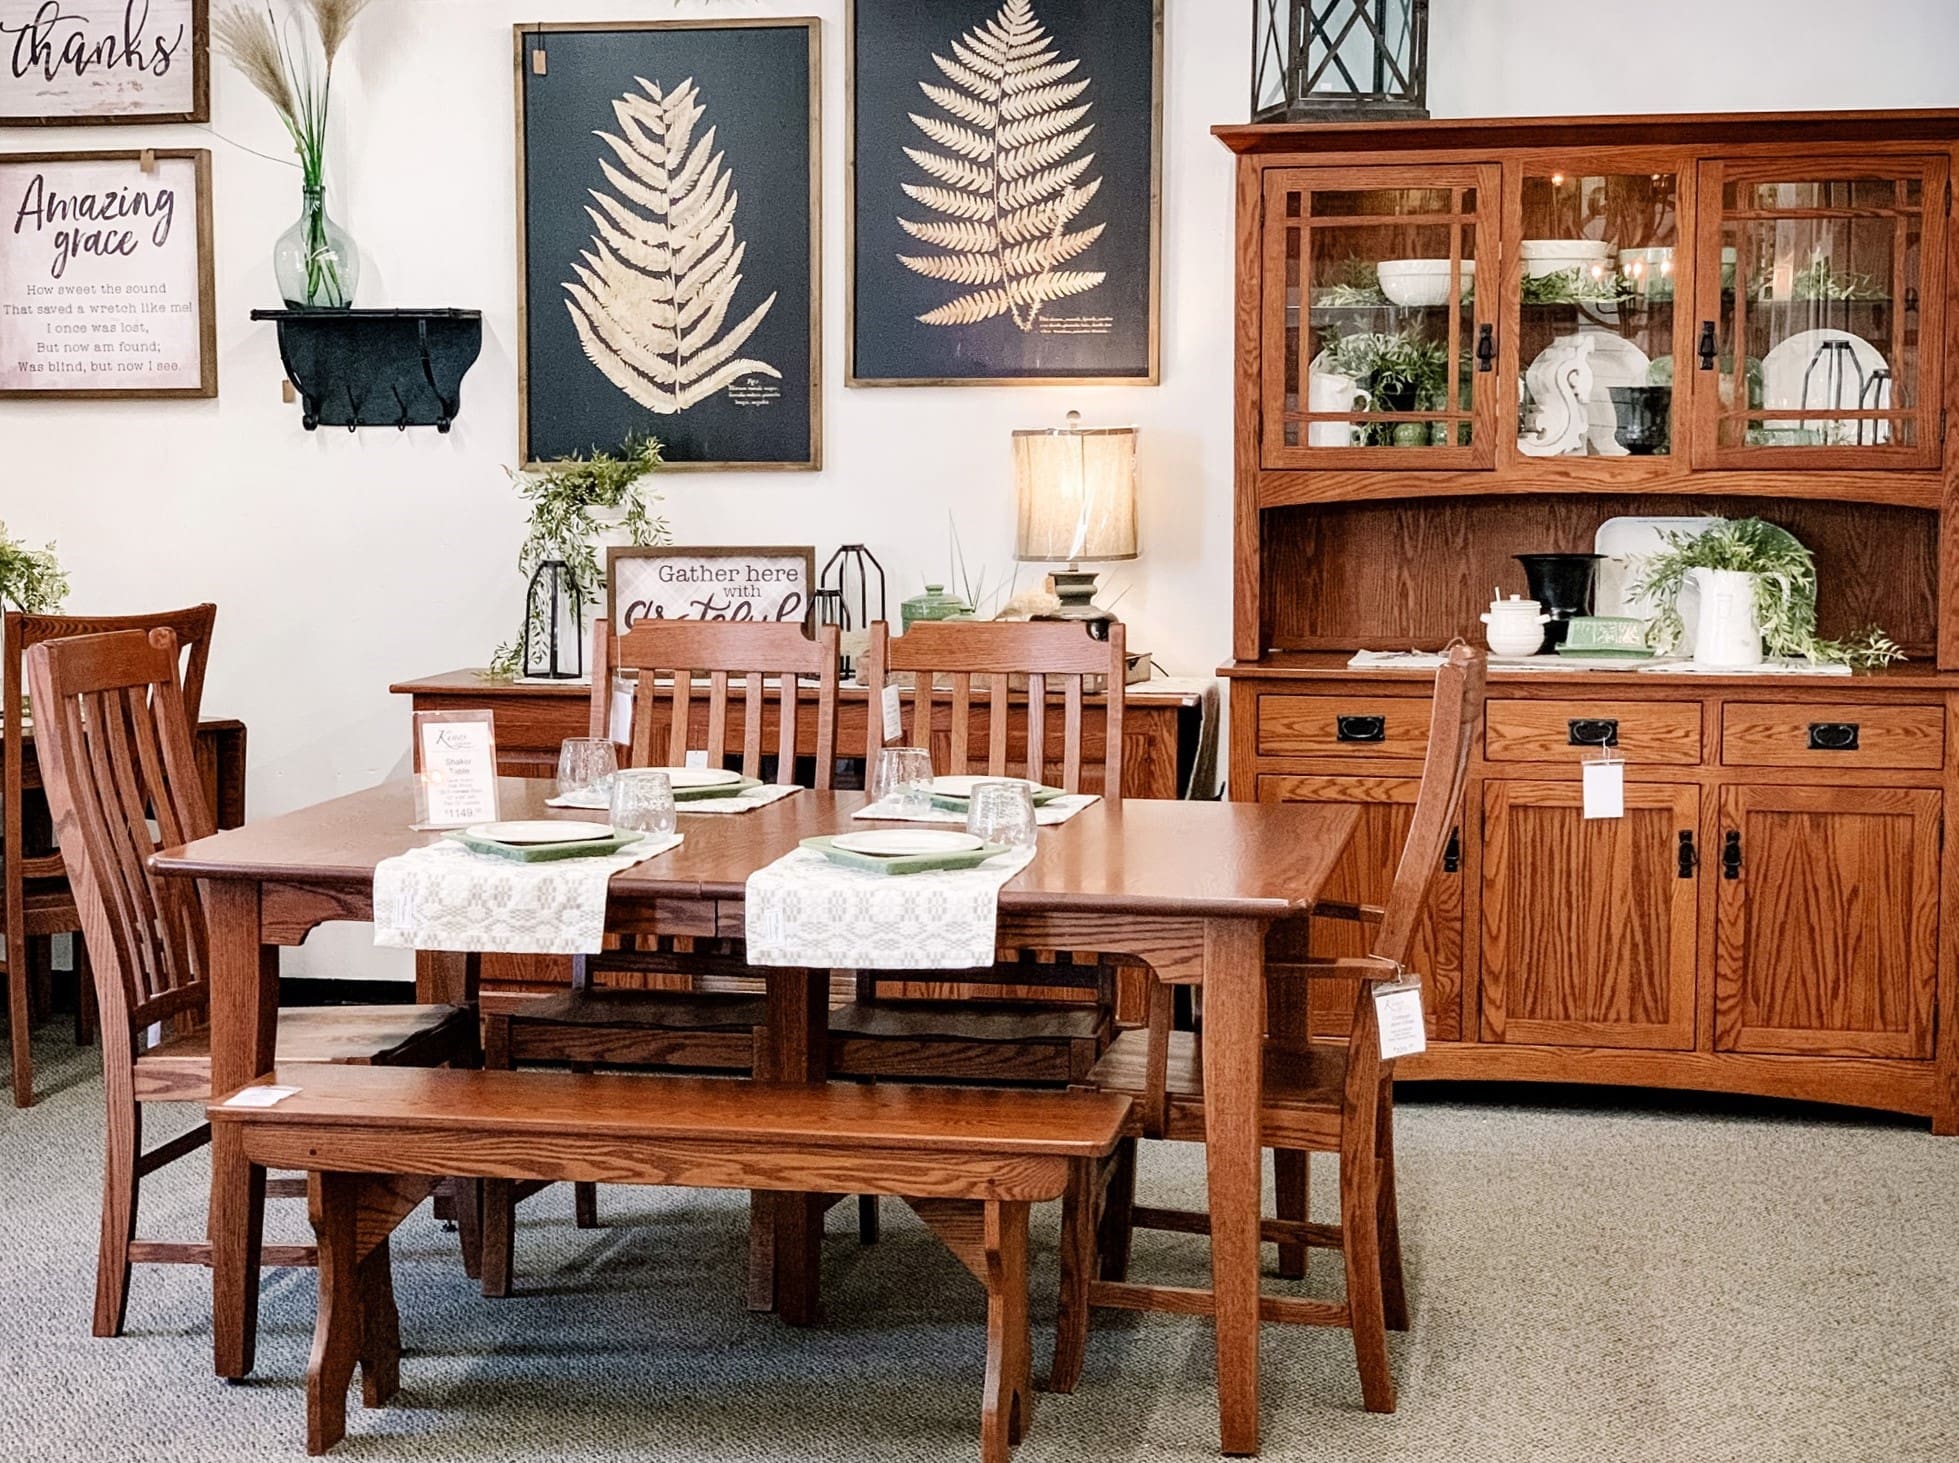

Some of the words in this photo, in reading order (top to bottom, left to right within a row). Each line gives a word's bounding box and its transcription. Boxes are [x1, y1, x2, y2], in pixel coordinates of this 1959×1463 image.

[0, 0, 184, 82] thanks
[14, 174, 174, 247] Amazing
[51, 228, 139, 279] grace
[26, 284, 54, 296] How
[57, 284, 97, 295] sweet
[101, 283, 122, 295] the
[125, 283, 167, 295] sound
[3, 303, 33, 315] That
[37, 303, 73, 315] saved
[77, 304, 85, 314] a
[90, 303, 137, 314] wretch
[141, 302, 166, 314] like
[55, 324, 88, 334] once
[91, 324, 117, 333] was
[120, 322, 150, 334] lost,
[37, 342, 60, 353] But
[64, 343, 90, 353] now
[94, 343, 114, 353] am
[18, 361, 44, 373] Was
[48, 360, 87, 374] blind,
[91, 360, 113, 372] but
[117, 361, 144, 372] now
[148, 360, 153, 372] I
[658, 565, 740, 583] Gather
[746, 565, 799, 583] here
[722, 584, 762, 599] with
